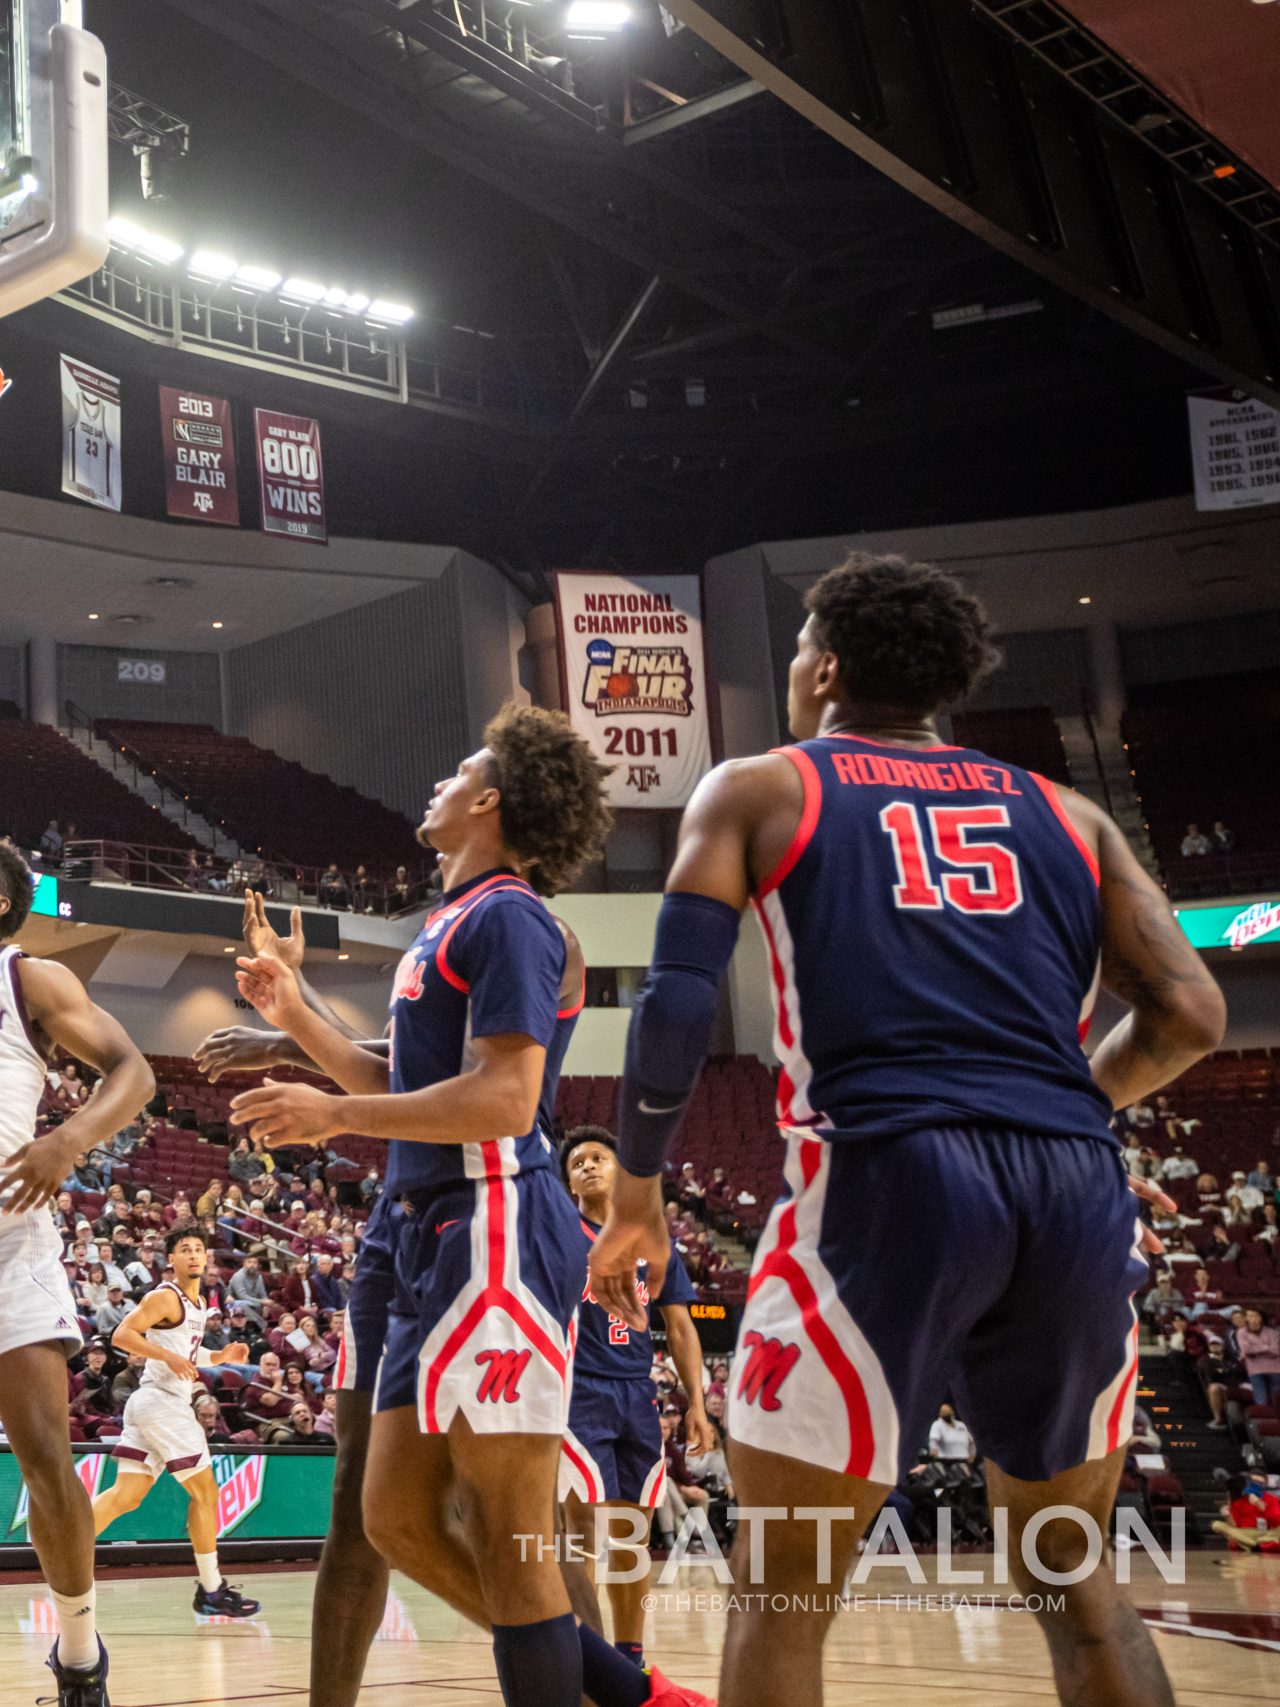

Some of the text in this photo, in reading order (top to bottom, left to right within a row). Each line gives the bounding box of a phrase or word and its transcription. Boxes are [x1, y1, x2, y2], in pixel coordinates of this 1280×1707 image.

[178, 397, 213, 418] 2013
[176, 447, 221, 469] GARY
[263, 438, 319, 481] 800
[175, 465, 227, 489] BLAIR
[266, 484, 321, 516] WINS
[287, 522, 308, 535] 2019
[584, 593, 674, 613] NATIONAL
[574, 615, 688, 634] CHAMPIONS
[591, 651, 611, 659] NCAA
[612, 648, 685, 673] FINAL
[118, 661, 165, 682] 209
[596, 700, 687, 712] INDIANAPOLIS
[604, 726, 678, 757] 2011
[831, 753, 1023, 795] RODRIGUEZ
[879, 801, 1024, 914] 15
[474, 1348, 532, 1404] M
[737, 1329, 802, 1412] M
